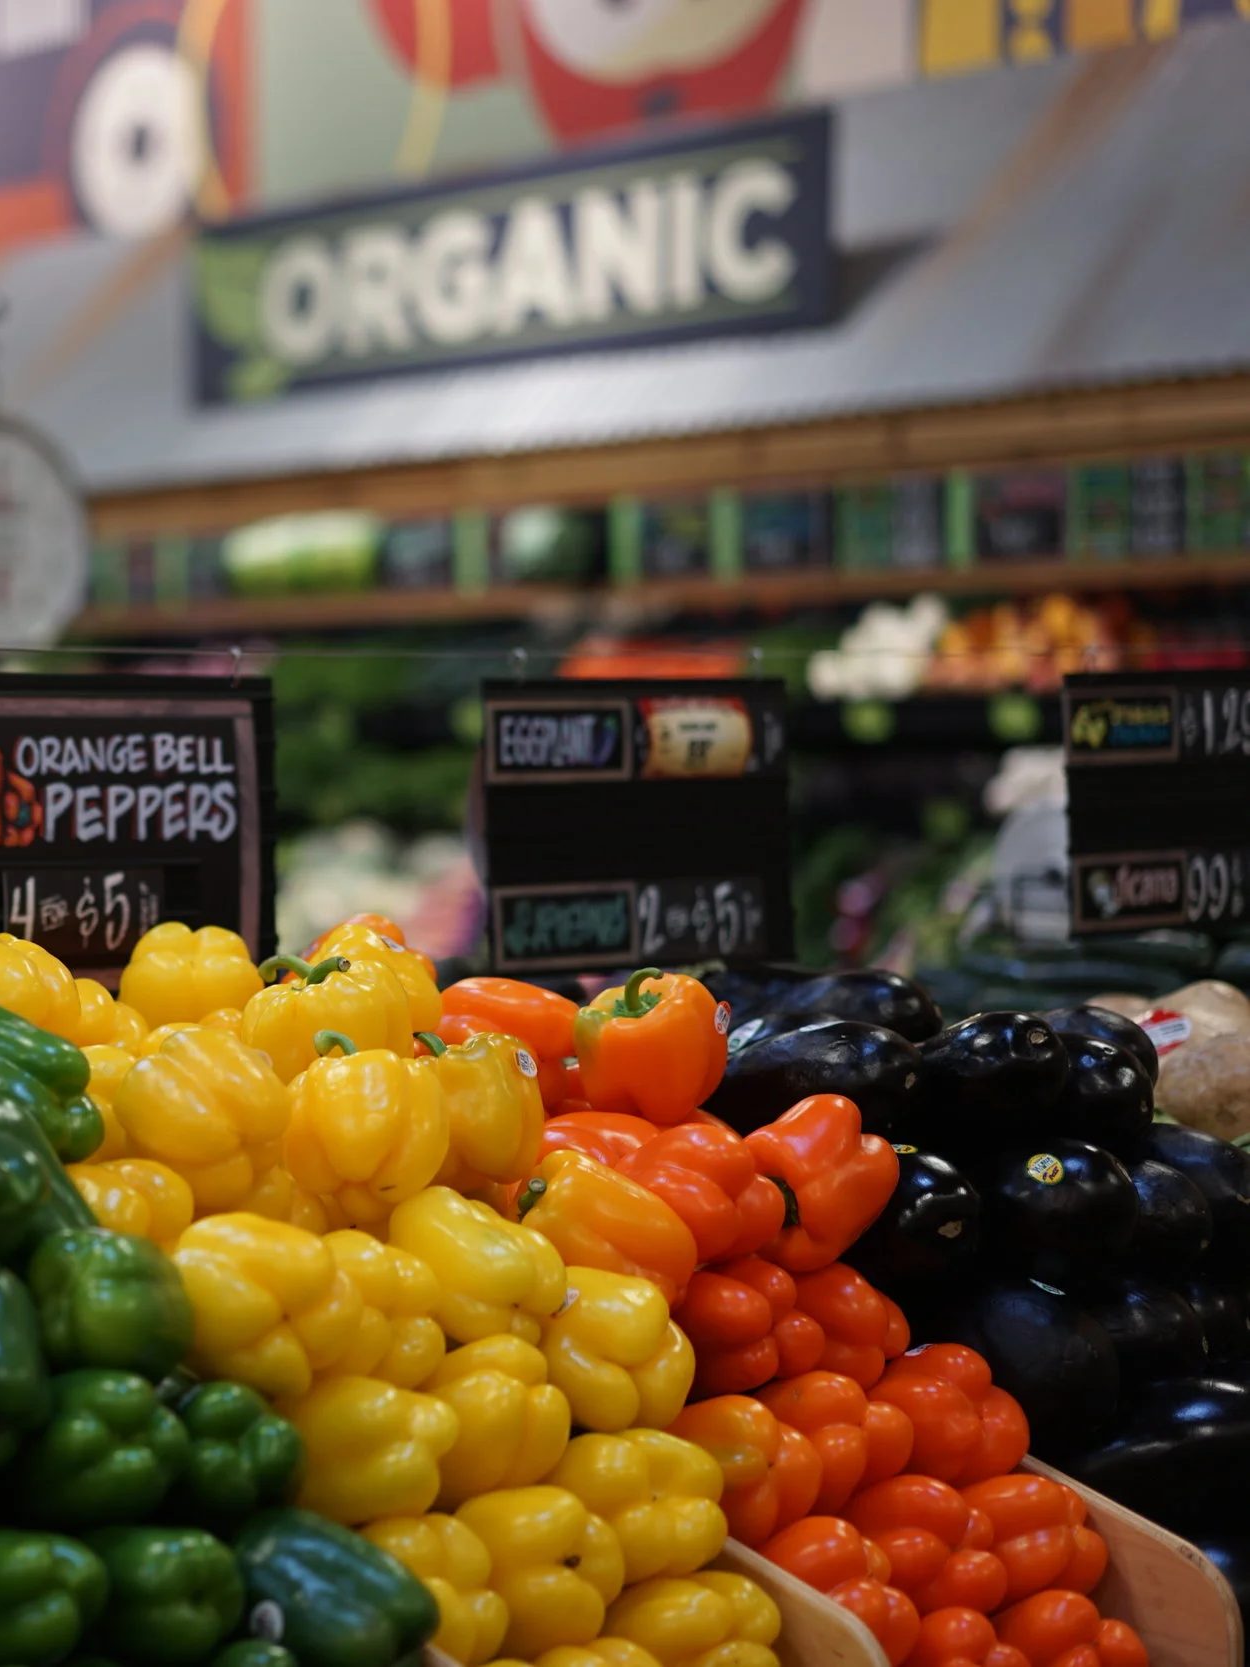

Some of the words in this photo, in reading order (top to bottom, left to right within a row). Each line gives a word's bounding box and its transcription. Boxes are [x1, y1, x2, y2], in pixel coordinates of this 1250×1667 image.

[261, 157, 797, 364] ORGANIC
[16, 734, 148, 776] ORANGE
[152, 733, 235, 774] BELL
[44, 780, 237, 842] PEPPERS
[10, 876, 35, 941] 4
[76, 871, 131, 950] $5
[639, 884, 667, 956] 2
